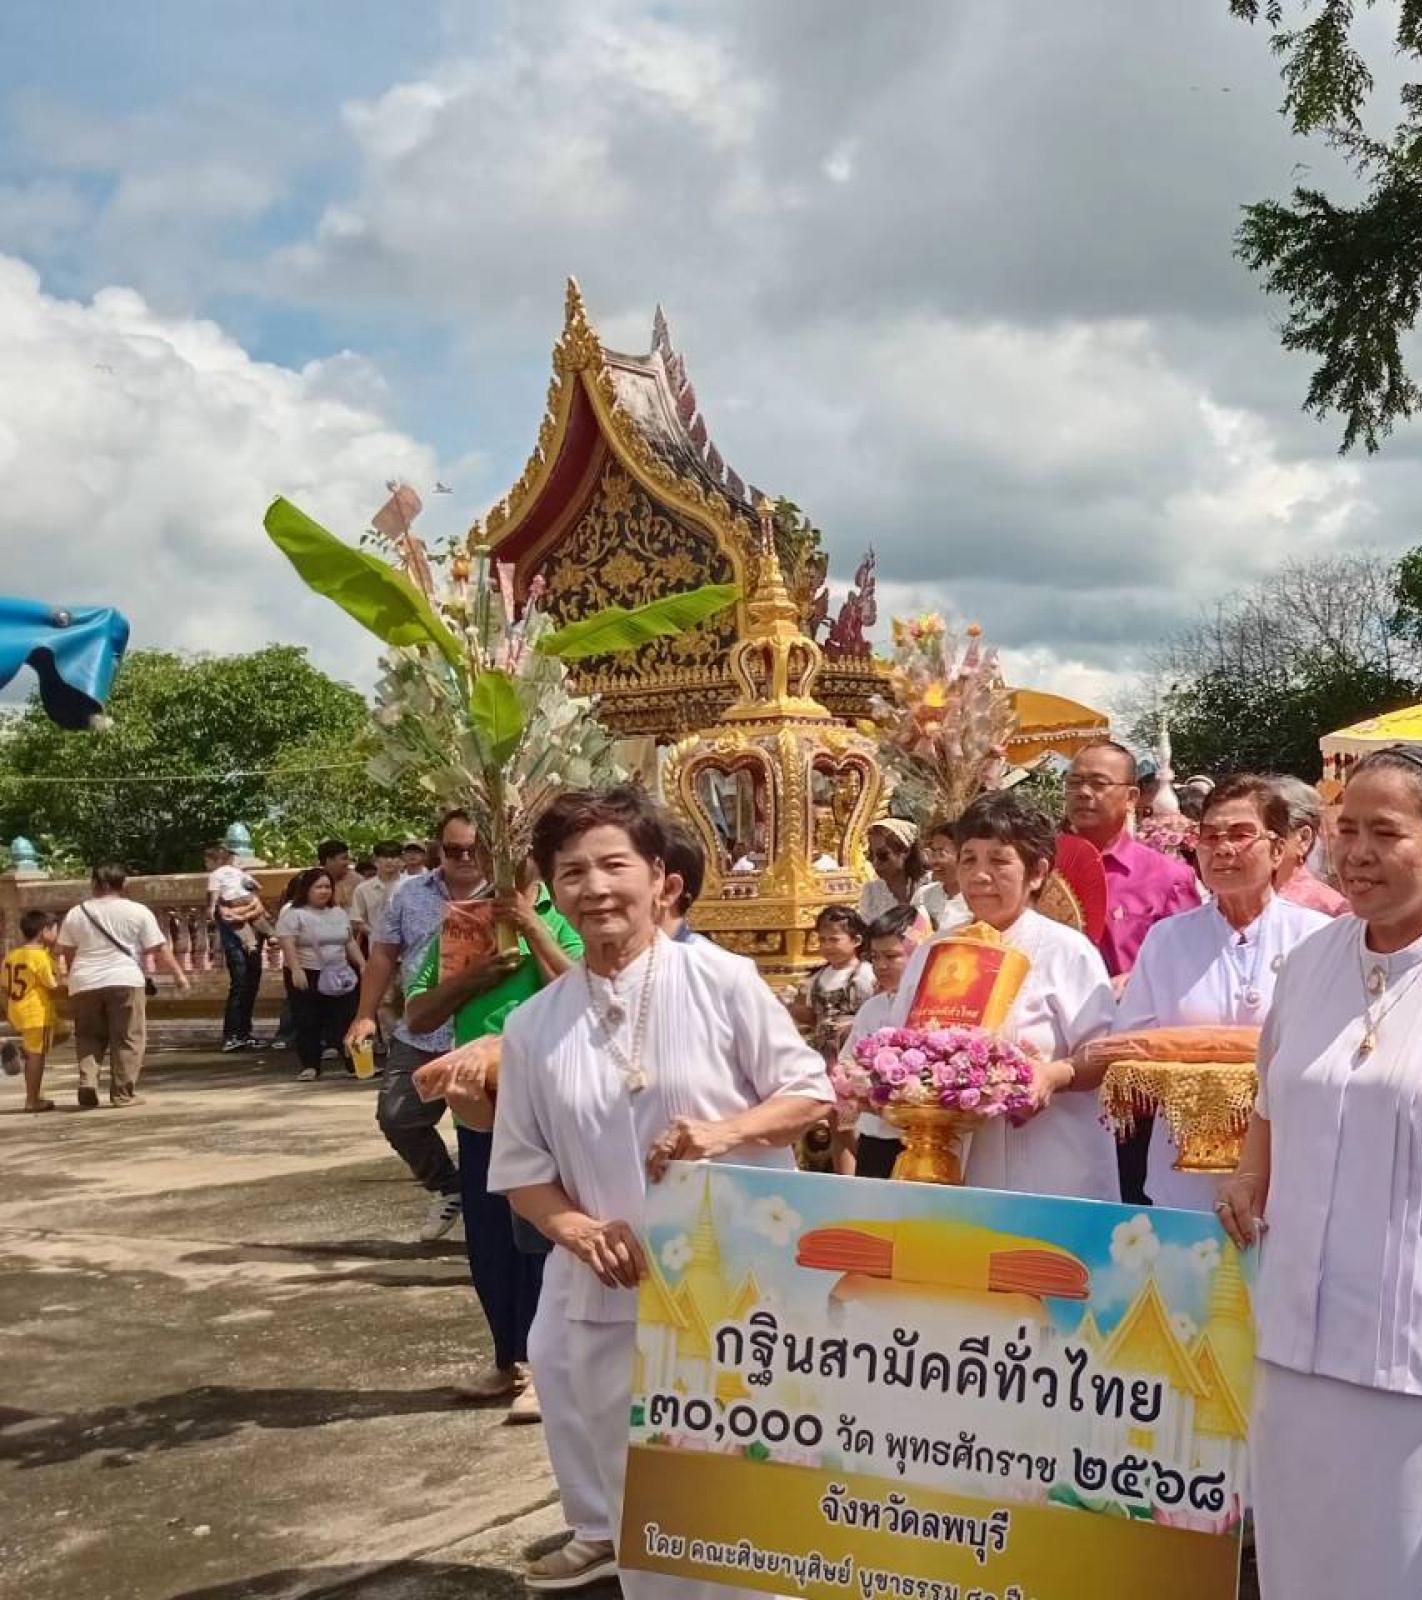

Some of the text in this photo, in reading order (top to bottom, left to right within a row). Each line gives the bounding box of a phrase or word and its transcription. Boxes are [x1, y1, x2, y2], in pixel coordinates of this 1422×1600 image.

[5, 962, 28, 1001] 15
[715, 1310, 1163, 1423] กฐินสามัคคีทั่วไทย
[650, 1392, 1226, 1512] ๓๐,๐๐๐ วัด พุทธศักราช ๒๕๖๘
[645, 1525, 683, 1555] โดย
[691, 1540, 852, 1588] คณะศิษยานุศิษย์
[821, 1483, 1009, 1564] จังหวัดลพบุรี
